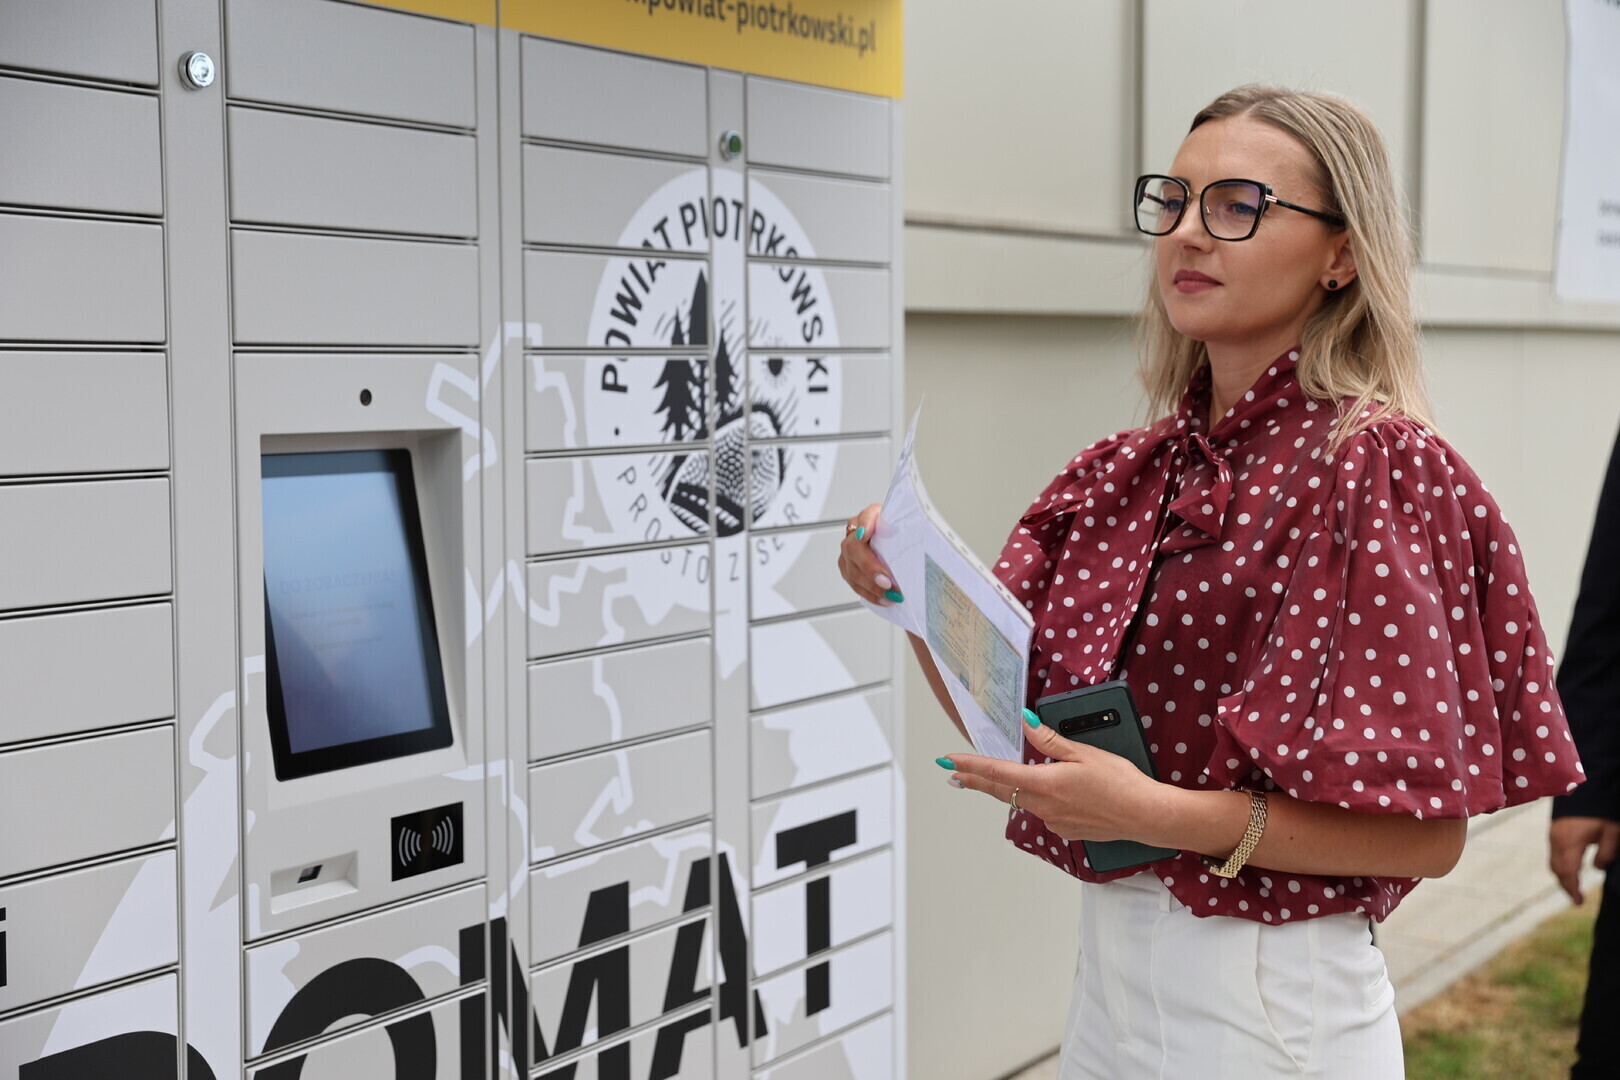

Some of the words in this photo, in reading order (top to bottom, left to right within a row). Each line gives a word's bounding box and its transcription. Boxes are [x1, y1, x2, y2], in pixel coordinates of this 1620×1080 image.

[601, 215, 673, 393] POWIAT
[679, 196, 828, 393] PIOTRKOWSKI
[617, 465, 710, 584] PROSTO
[729, 553, 741, 582] Z
[756, 451, 820, 566] SERCA
